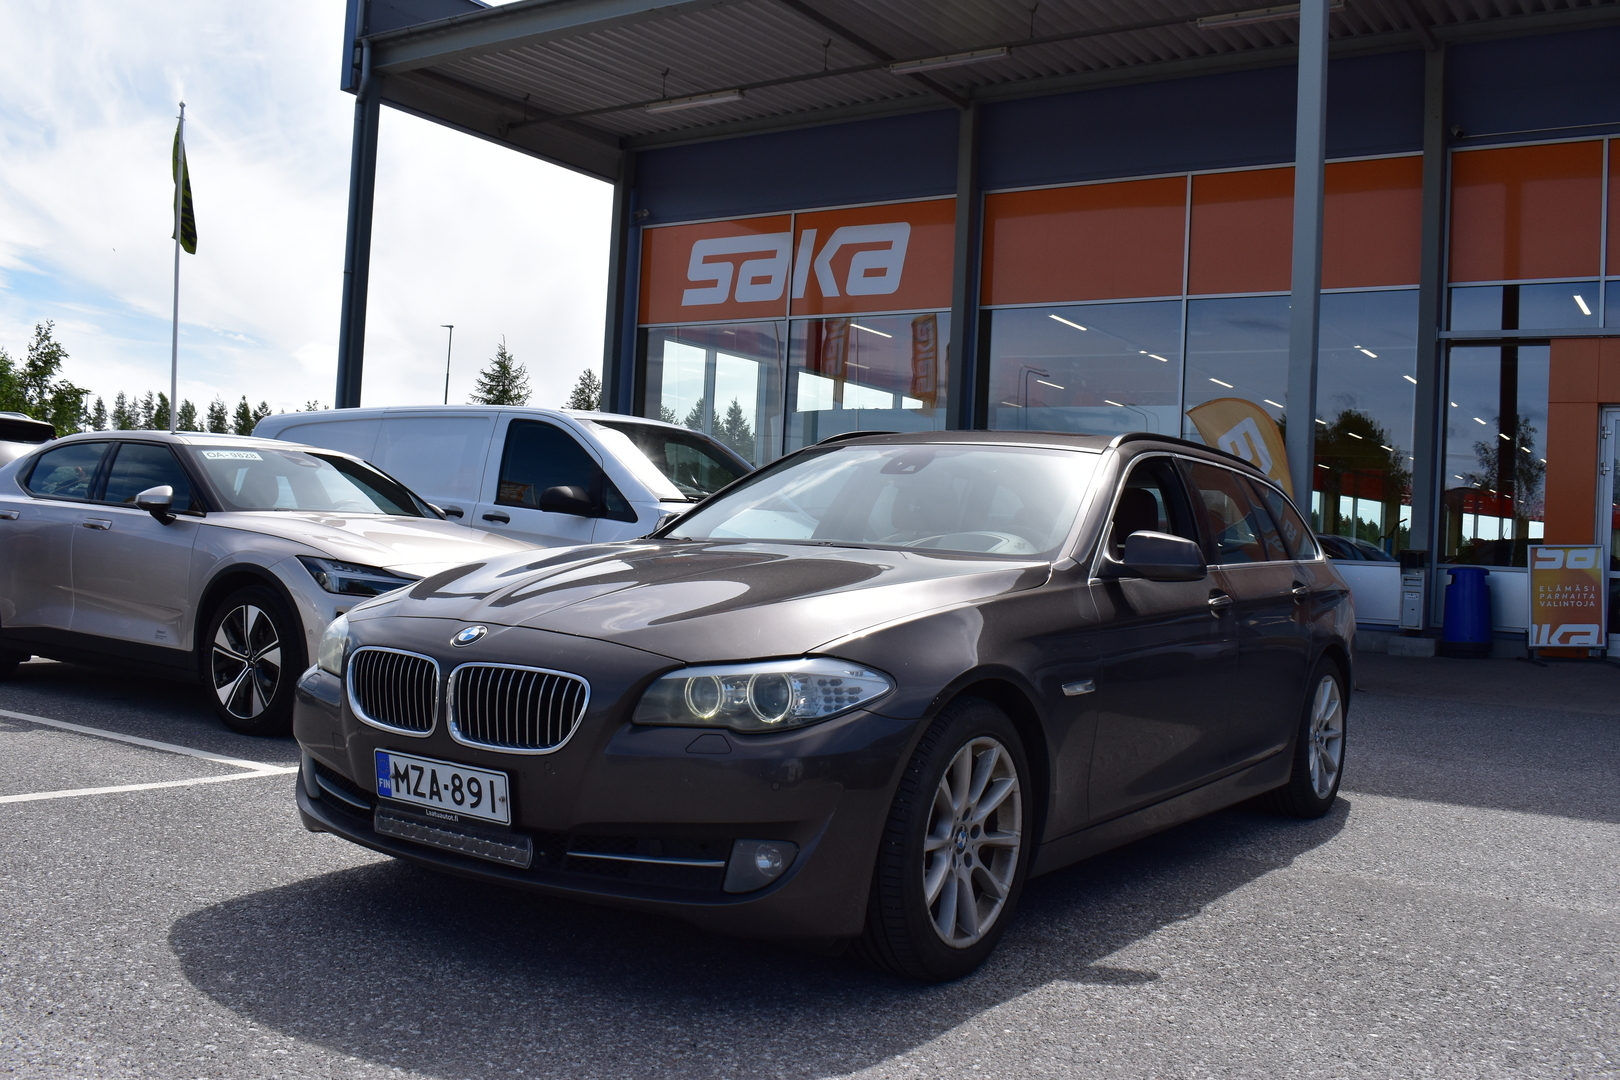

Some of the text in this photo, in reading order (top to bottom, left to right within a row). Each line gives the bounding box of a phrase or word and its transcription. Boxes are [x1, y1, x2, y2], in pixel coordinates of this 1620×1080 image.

[1539, 584, 1595, 592] ELÄMÄSI
[379, 778, 391, 789] FIN
[393, 761, 496, 813] MZA-891
[425, 809, 459, 823] Laatuautot.fi
